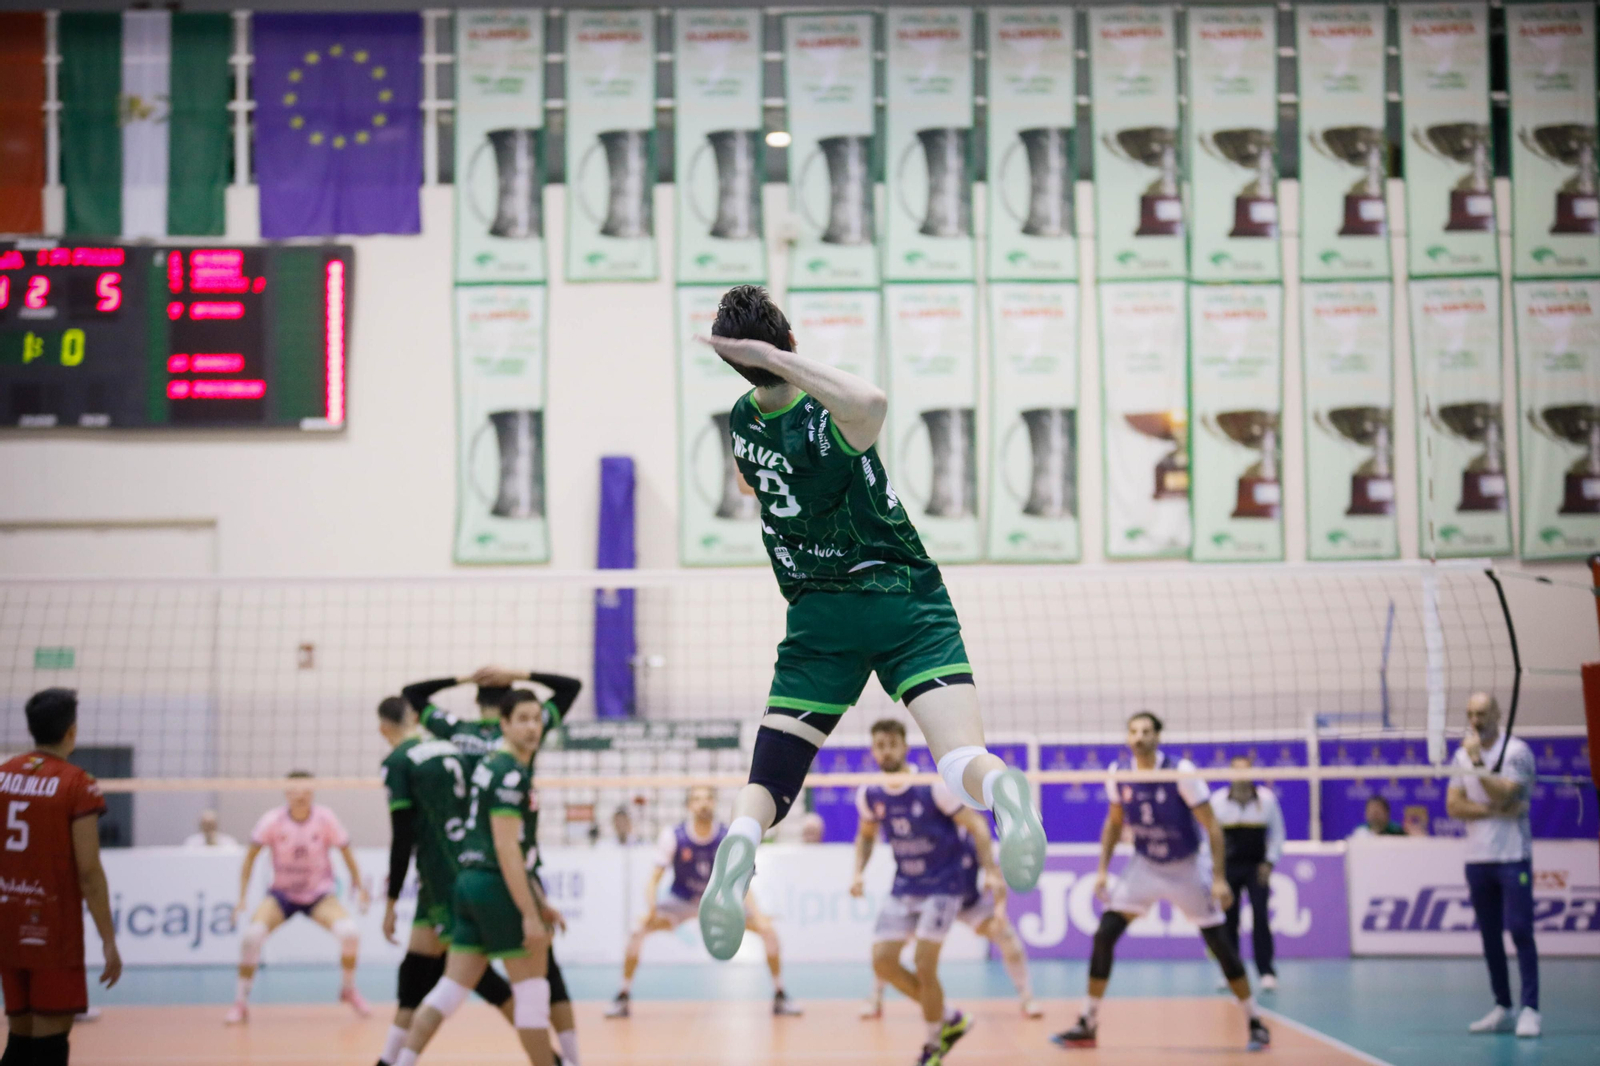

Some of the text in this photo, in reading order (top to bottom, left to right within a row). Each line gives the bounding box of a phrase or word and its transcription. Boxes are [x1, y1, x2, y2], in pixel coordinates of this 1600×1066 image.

[60, 328, 85, 366] 0
[5, 801, 30, 852] 5
[111, 891, 237, 949] icaja
